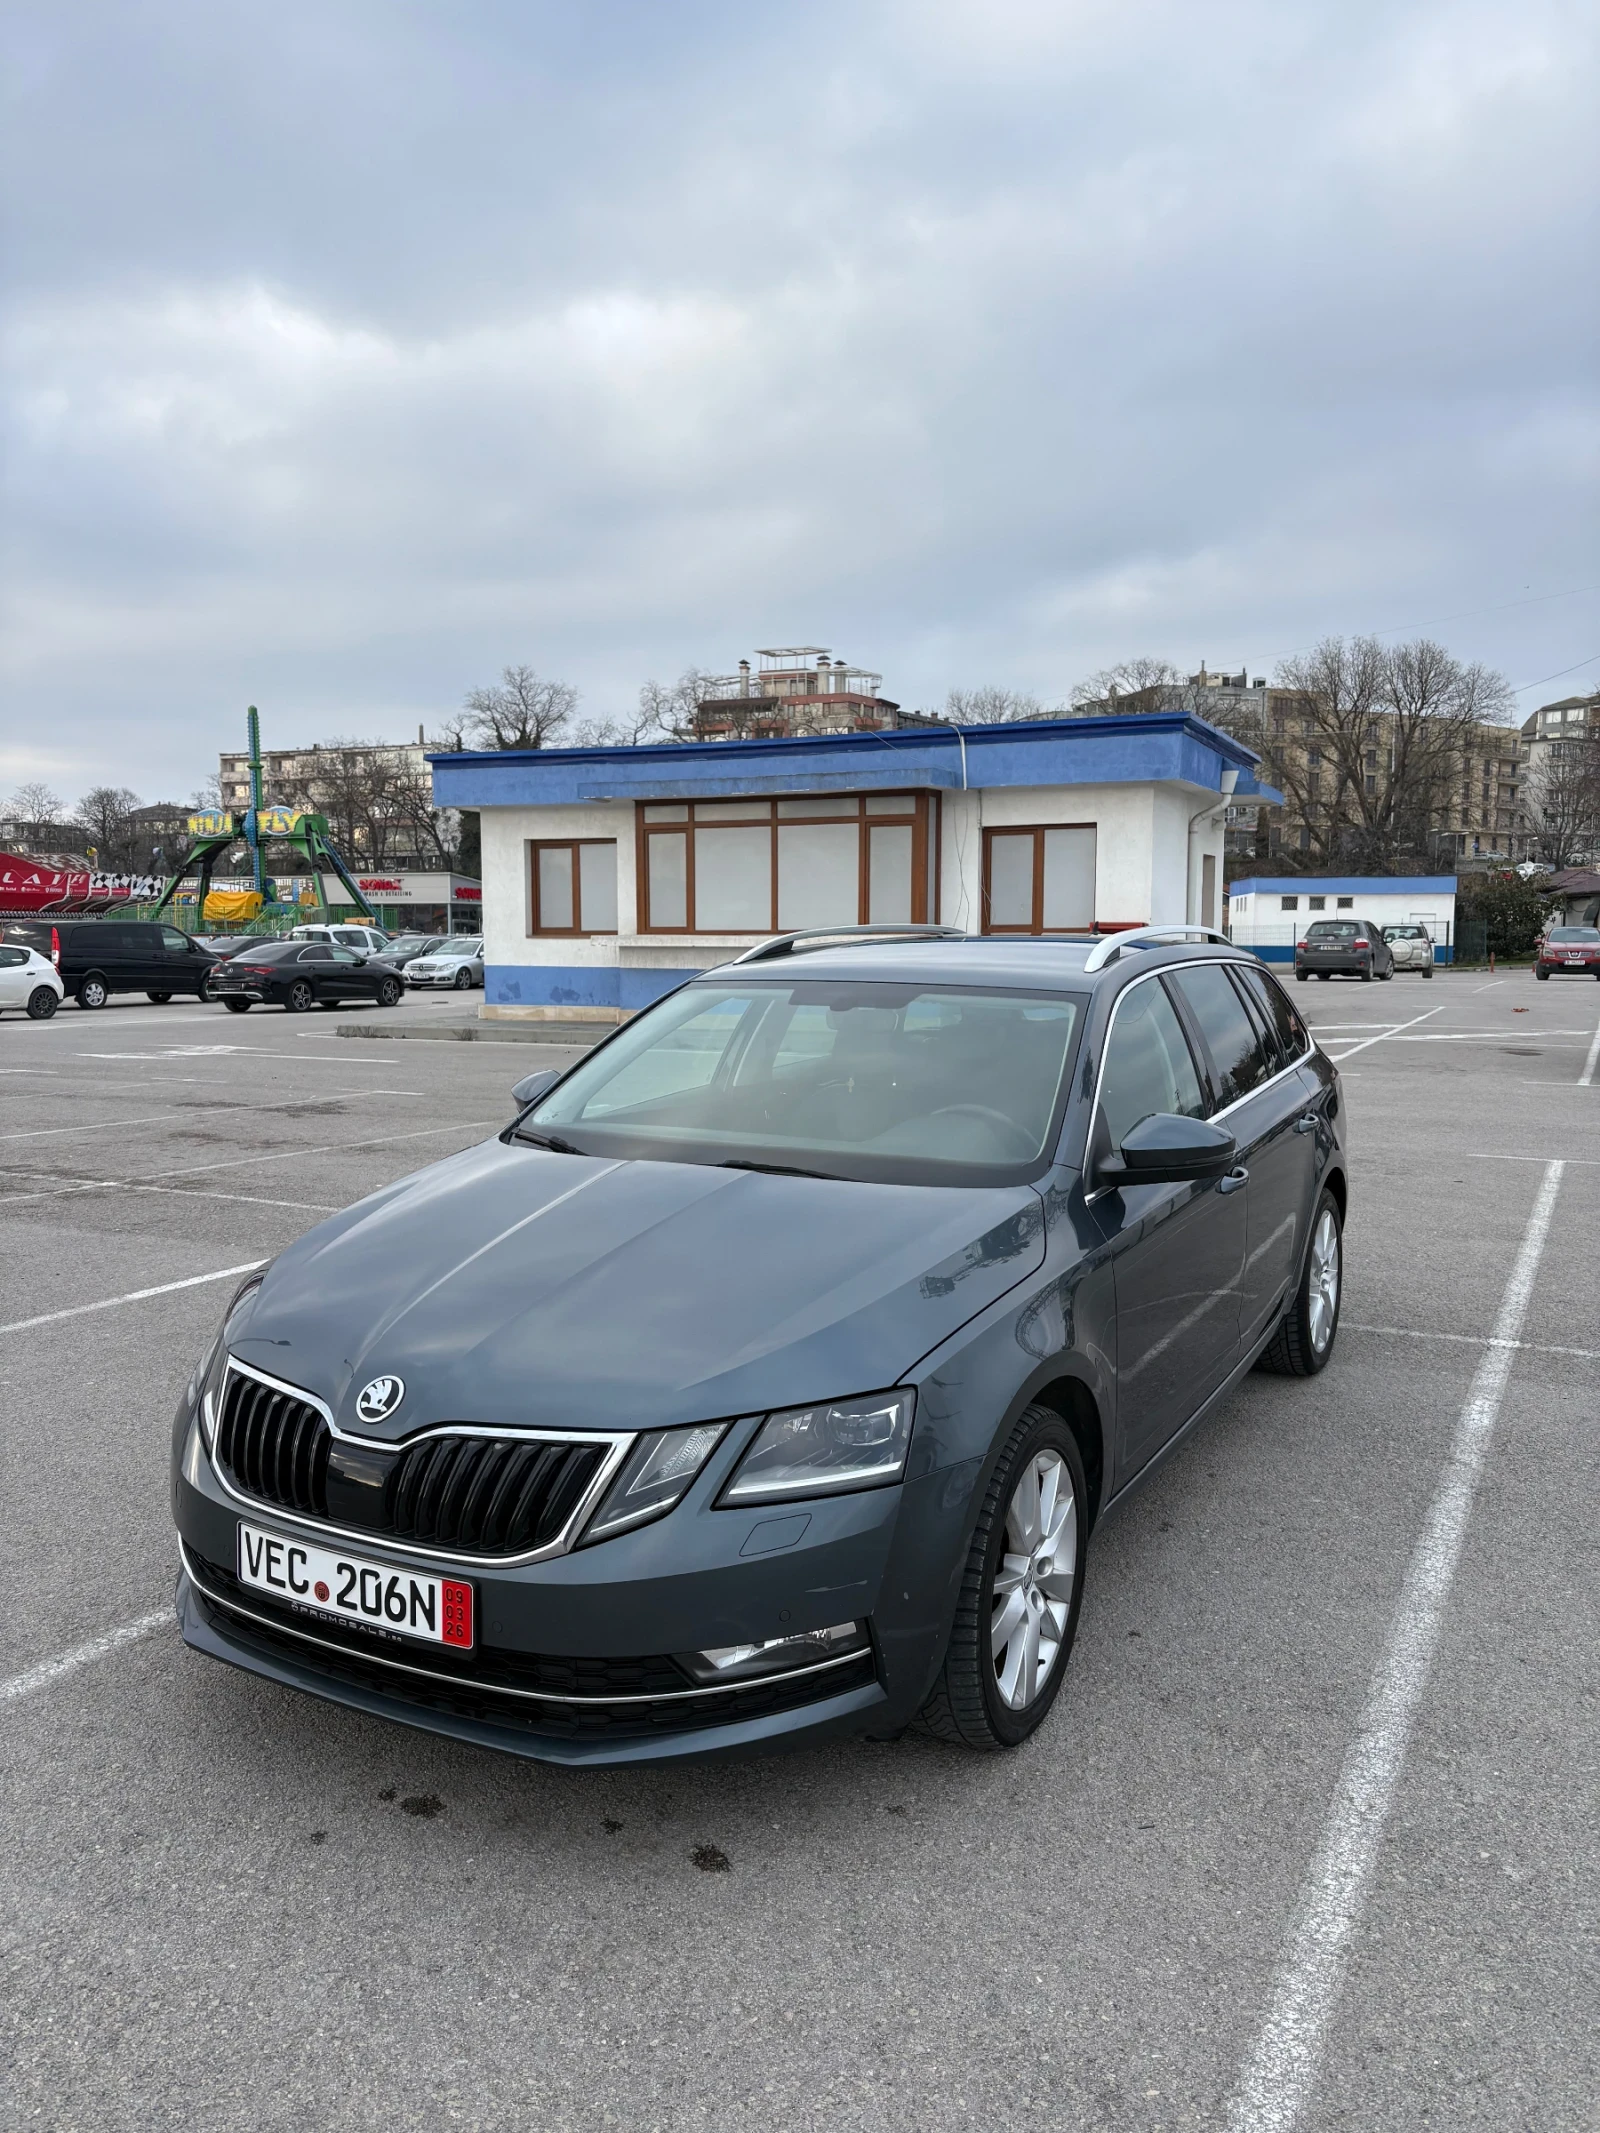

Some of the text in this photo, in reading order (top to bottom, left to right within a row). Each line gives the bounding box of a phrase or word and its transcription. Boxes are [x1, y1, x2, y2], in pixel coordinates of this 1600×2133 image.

[257, 809, 303, 832] FLY
[359, 878, 403, 891] SONAX
[455, 887, 482, 900] SONA
[245, 1531, 435, 1631] VEC 206N
[446, 1587, 464, 1604] 09
[446, 1604, 464, 1621] 03
[446, 1621, 464, 1638] 26
